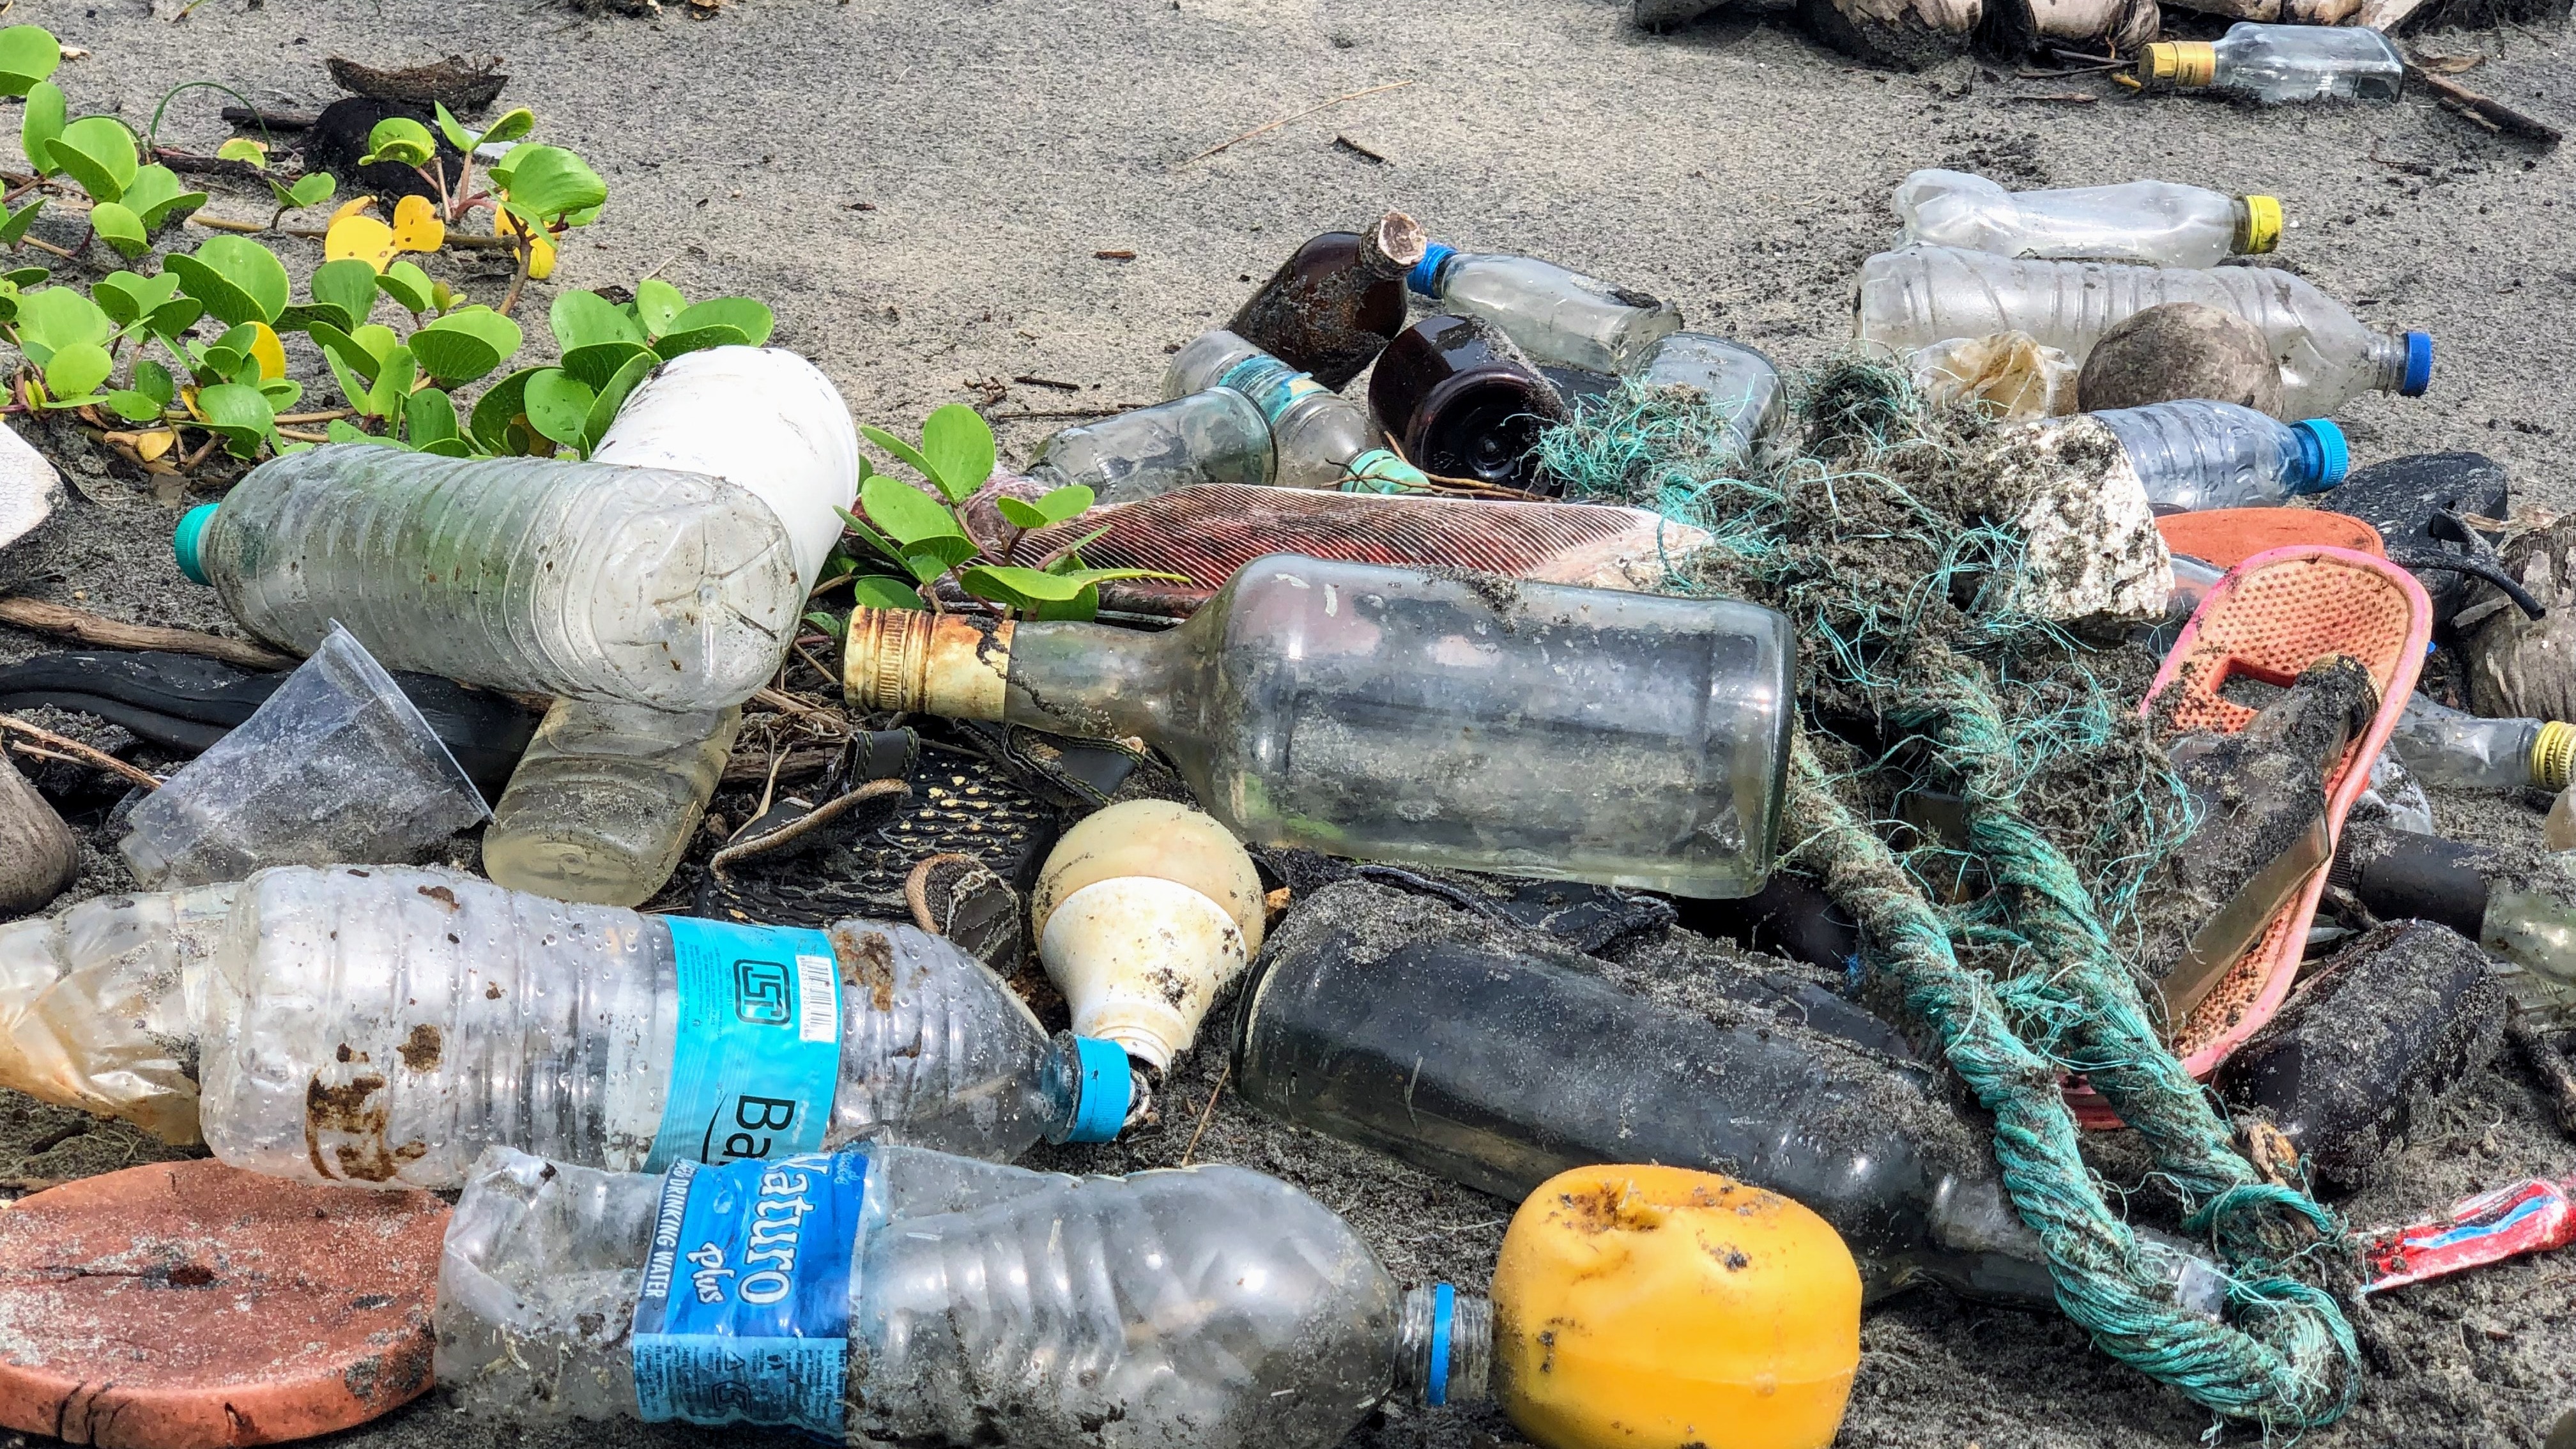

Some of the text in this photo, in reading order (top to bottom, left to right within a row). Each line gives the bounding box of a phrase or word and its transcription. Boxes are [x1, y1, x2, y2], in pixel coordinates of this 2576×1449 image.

[719, 1095, 796, 1165] Ba
[656, 1177, 689, 1248] DRINKING
[645, 1252, 675, 1298] WATER
